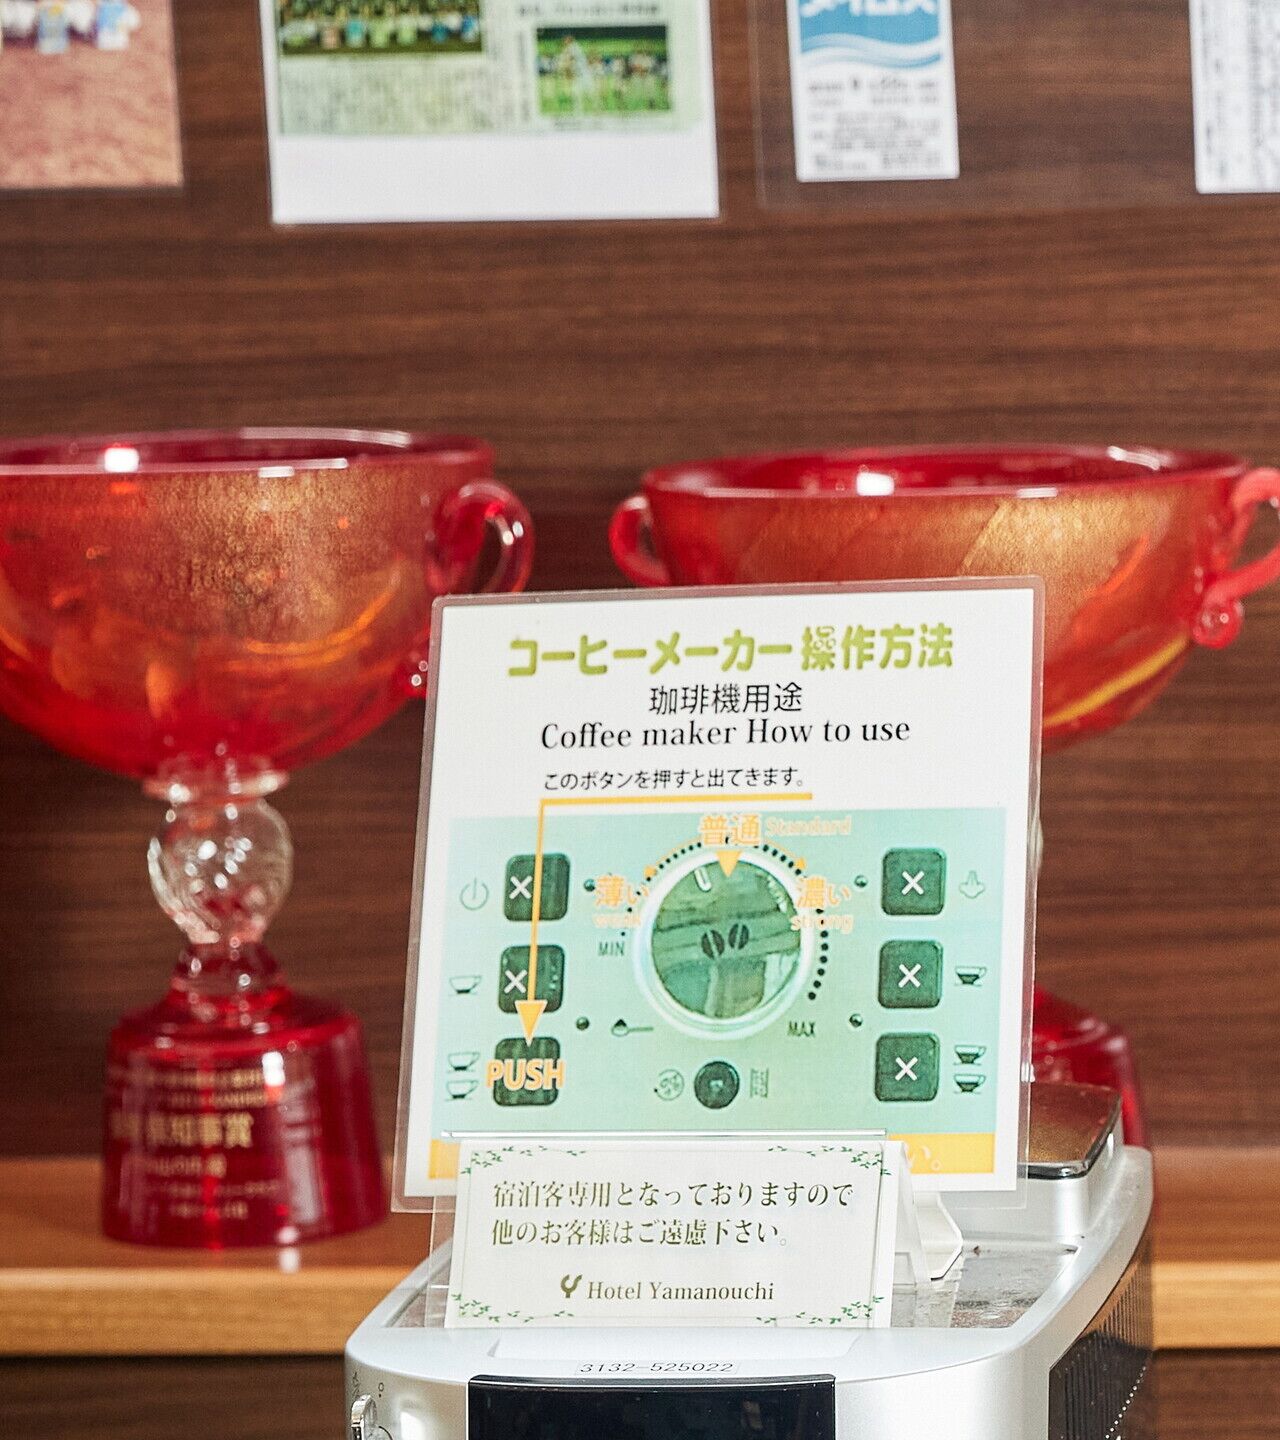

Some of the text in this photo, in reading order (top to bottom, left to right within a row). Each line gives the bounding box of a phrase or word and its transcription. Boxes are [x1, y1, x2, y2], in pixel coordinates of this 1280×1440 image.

[509, 622, 953, 677] コーヒーメーカー操作方法
[648, 682, 804, 715] 珈琲機用途
[541, 718, 911, 749] Coffee maker How to use
[544, 766, 805, 790] このボタンを押すと出てきます。
[700, 813, 761, 846] 普通
[766, 816, 852, 836] Standard
[595, 874, 649, 907] 薄い
[796, 876, 850, 908] 濃い
[791, 914, 854, 934] strong
[597, 941, 626, 957] MIN
[787, 1020, 817, 1038] MAX
[486, 1058, 566, 1091] PUSH
[492, 1180, 855, 1209] 宿泊客専用となっておりますので
[491, 1218, 789, 1248] 他のお客様はご遠慮下さい。
[587, 1280, 775, 1302] Hotel Yamanouchi
[580, 1362, 734, 1373] 3132-525022
